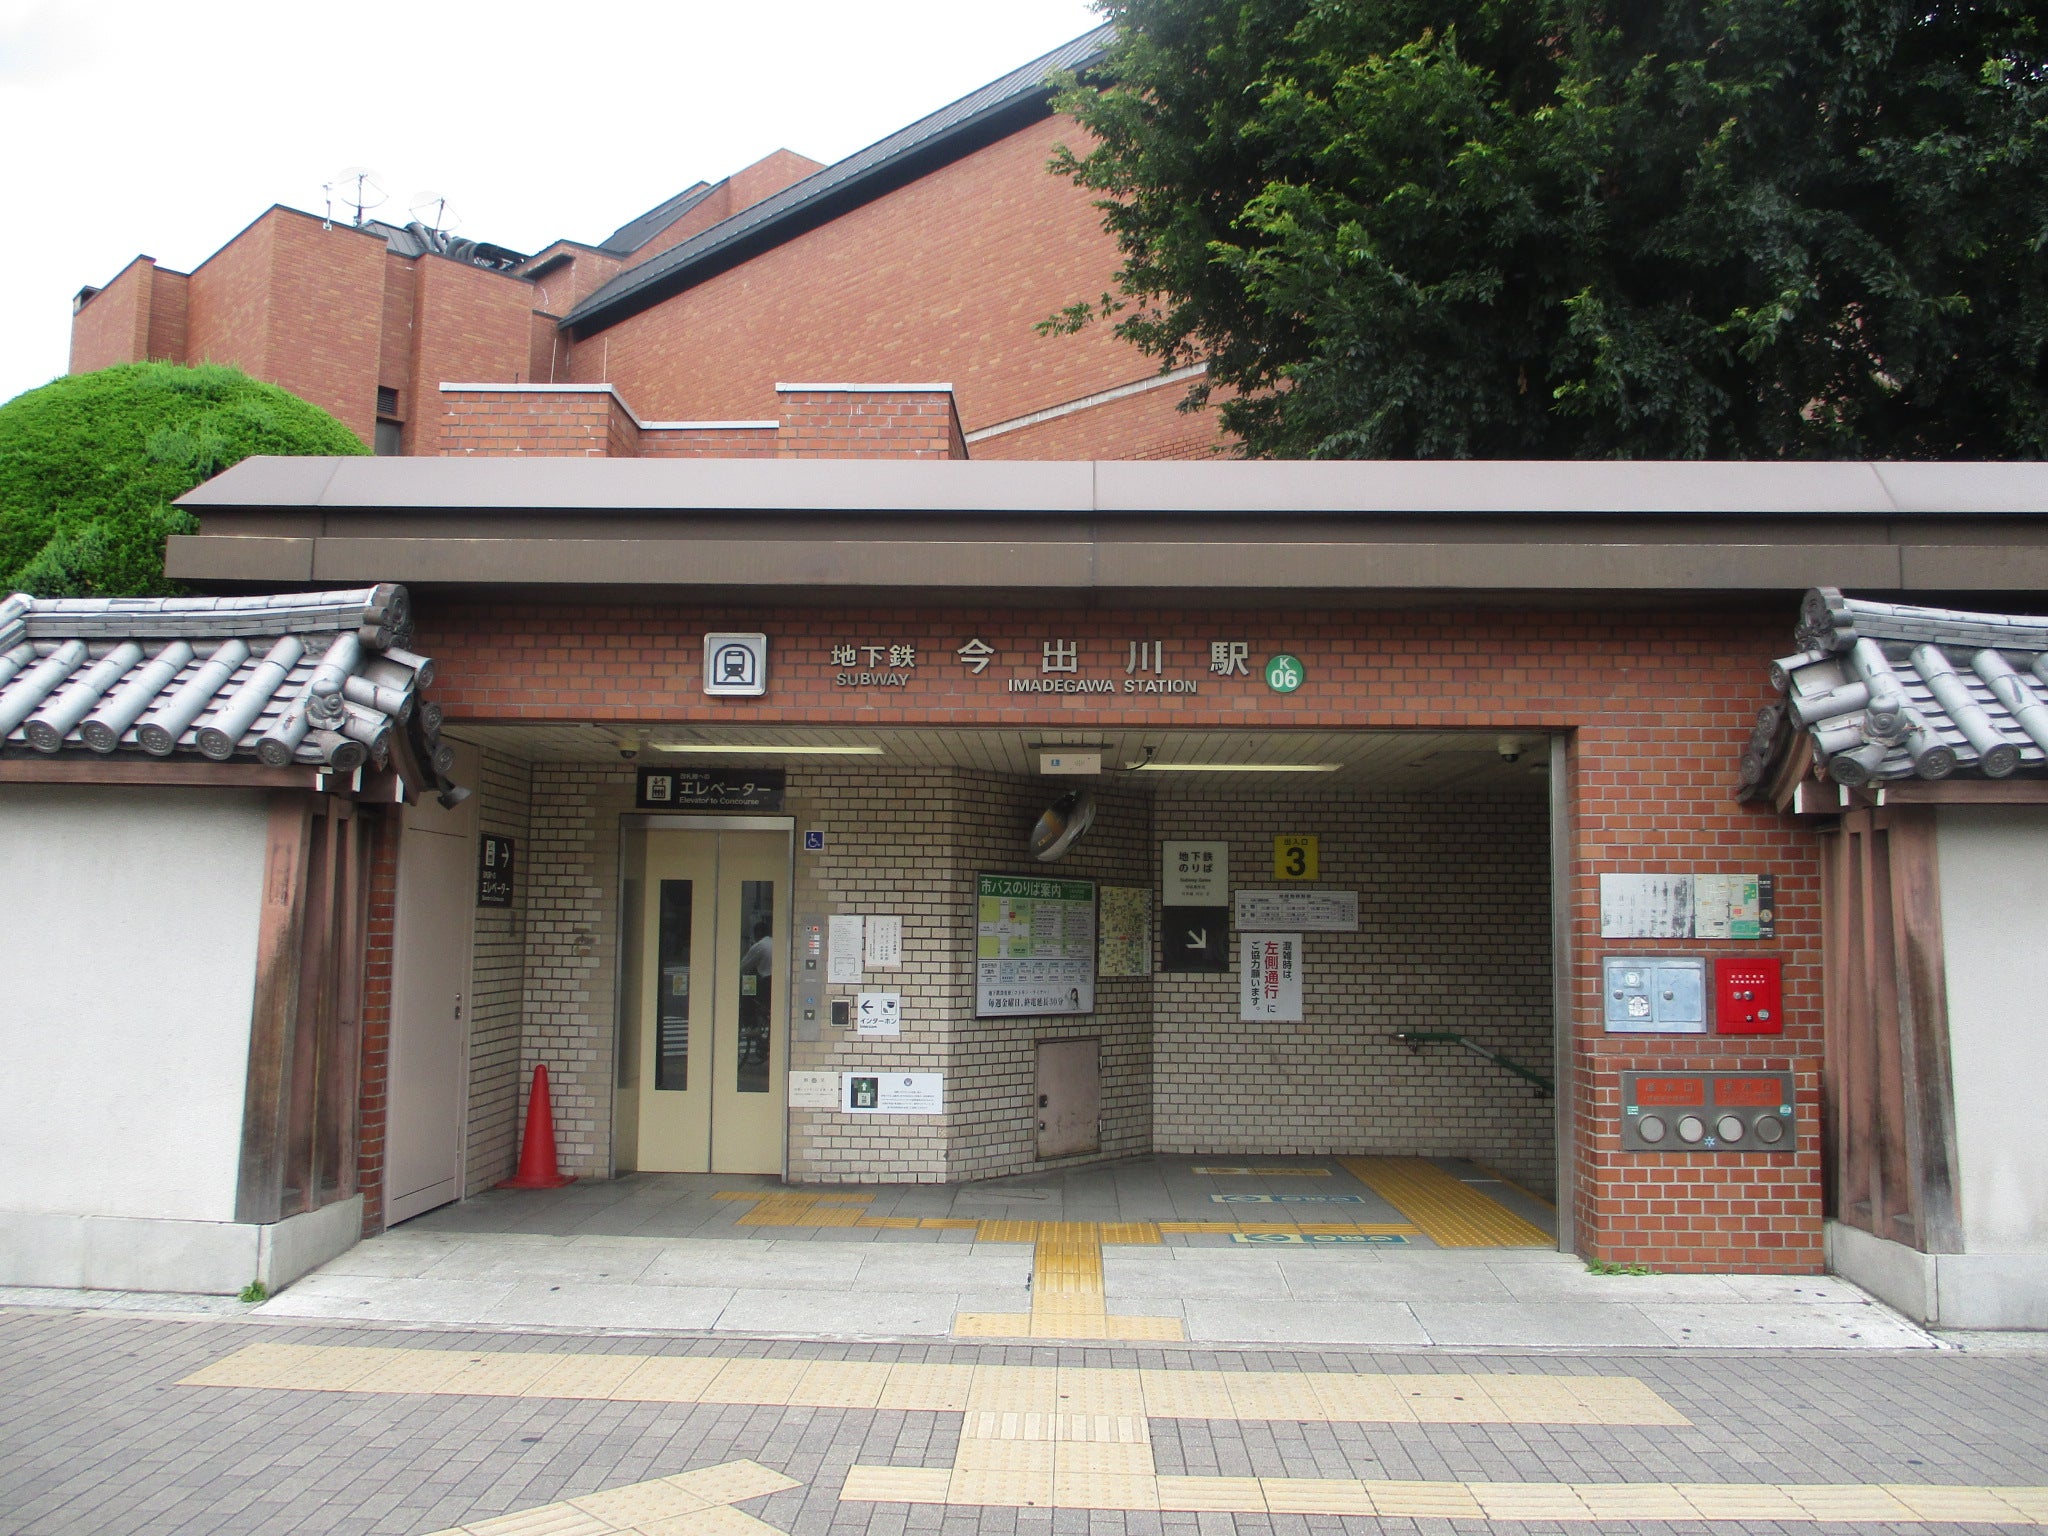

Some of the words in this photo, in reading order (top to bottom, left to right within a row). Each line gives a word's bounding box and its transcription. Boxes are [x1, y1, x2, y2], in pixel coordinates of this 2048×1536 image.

[830, 644, 915, 668] 地下鉄
[957, 638, 1250, 676] 今出川駅
[1279, 657, 1289, 669] K
[836, 672, 910, 686] SUBWAY
[1008, 679, 1115, 693] IMADEGAWA
[1124, 679, 1197, 693] STATION
[1270, 669, 1298, 688] 06
[680, 781, 771, 796] エレベーター
[1284, 838, 1308, 846] 出入口
[1179, 851, 1213, 861] 地下鉄
[1286, 847, 1306, 876] 3
[1179, 863, 1213, 873] のりば
[981, 878, 1061, 898] 市バスのりば案内
[1264, 940, 1279, 1013] 左側通行に
